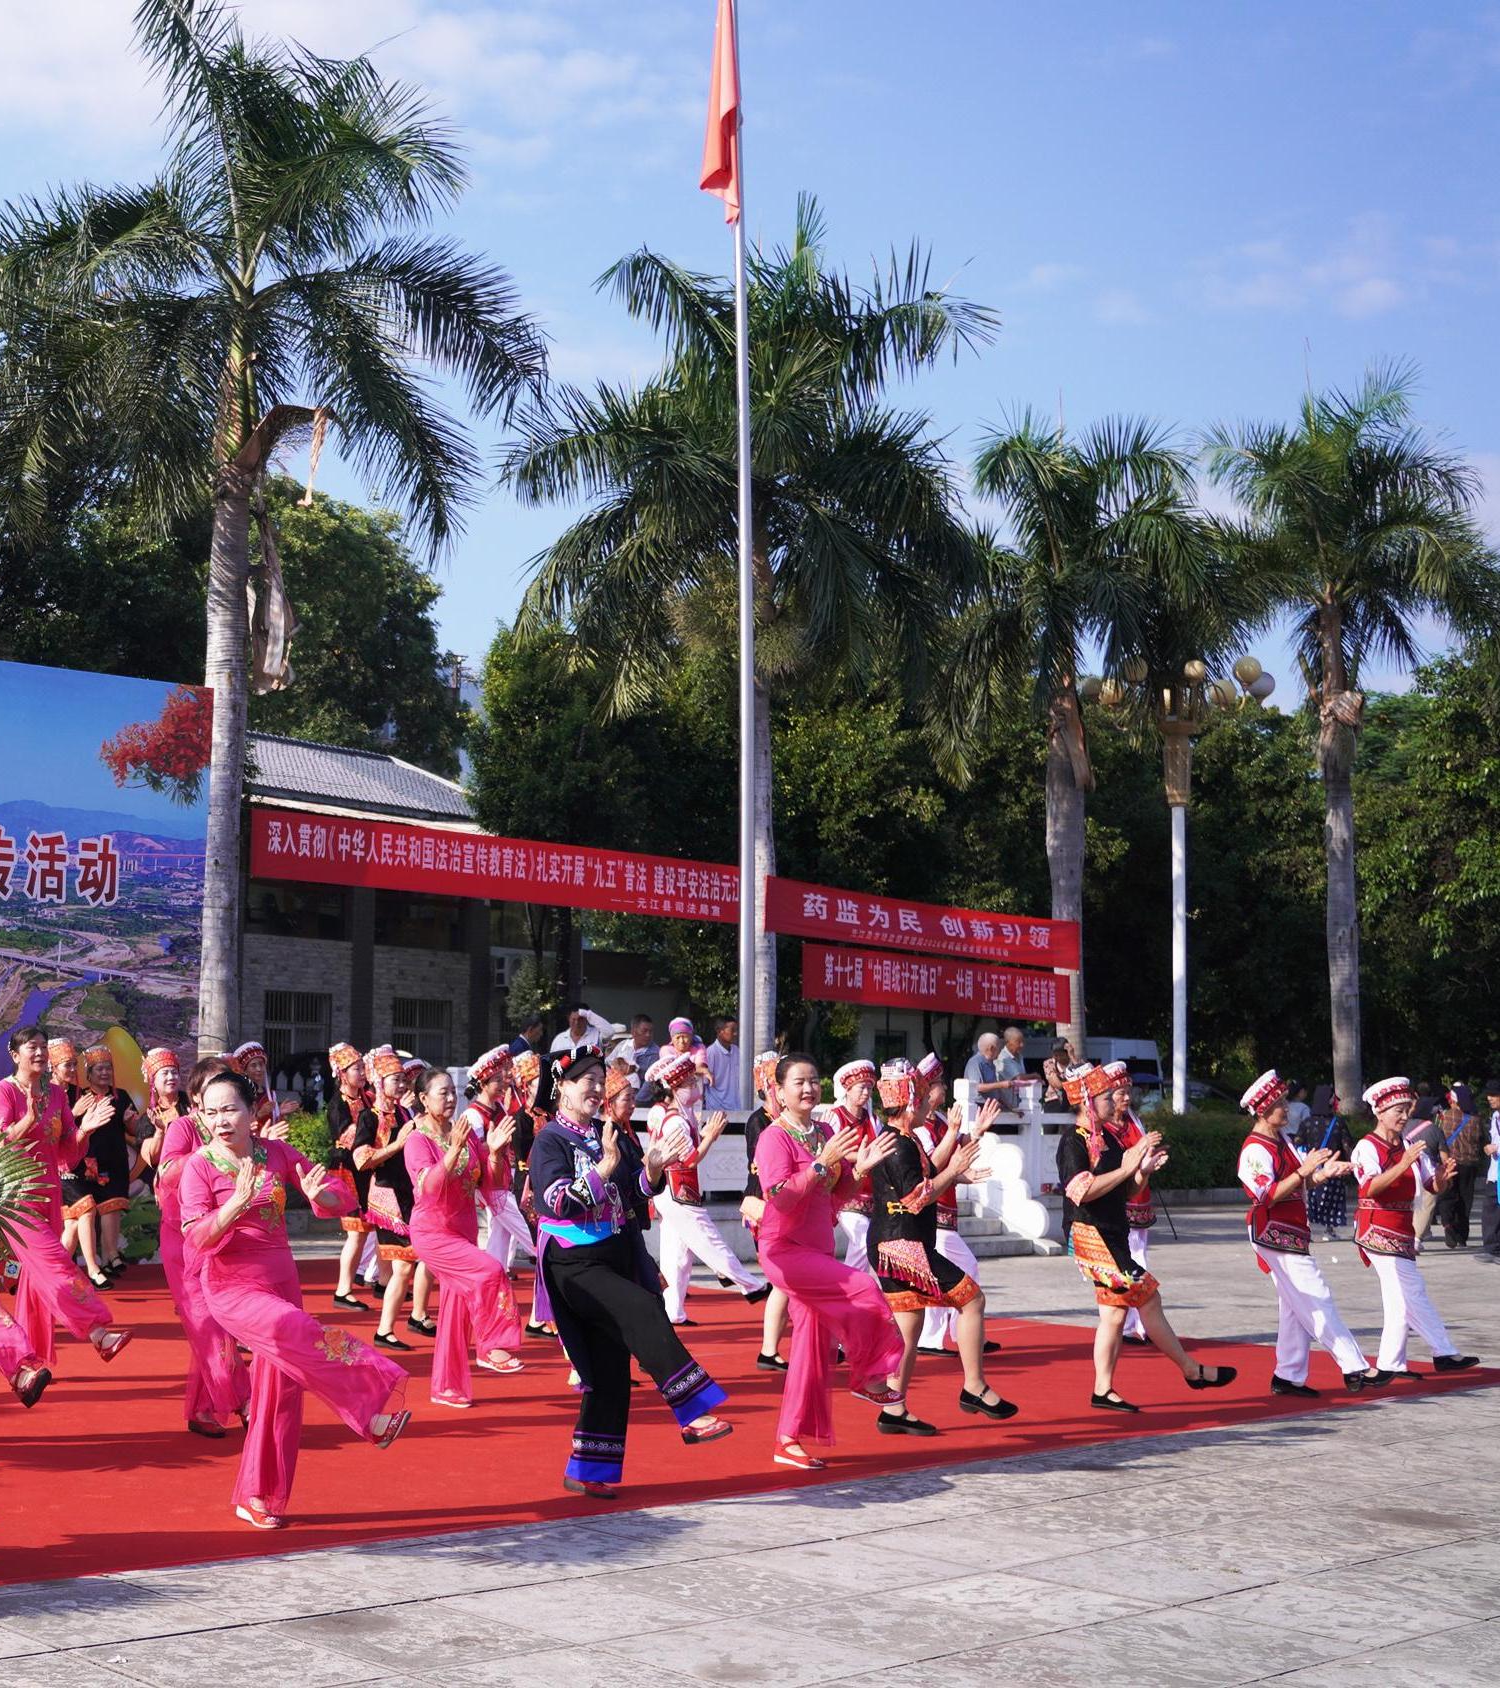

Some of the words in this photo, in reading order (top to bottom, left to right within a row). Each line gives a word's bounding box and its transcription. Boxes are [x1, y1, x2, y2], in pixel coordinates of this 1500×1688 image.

[802, 892, 923, 934] 药监为民
[939, 914, 1051, 950] 创新引领
